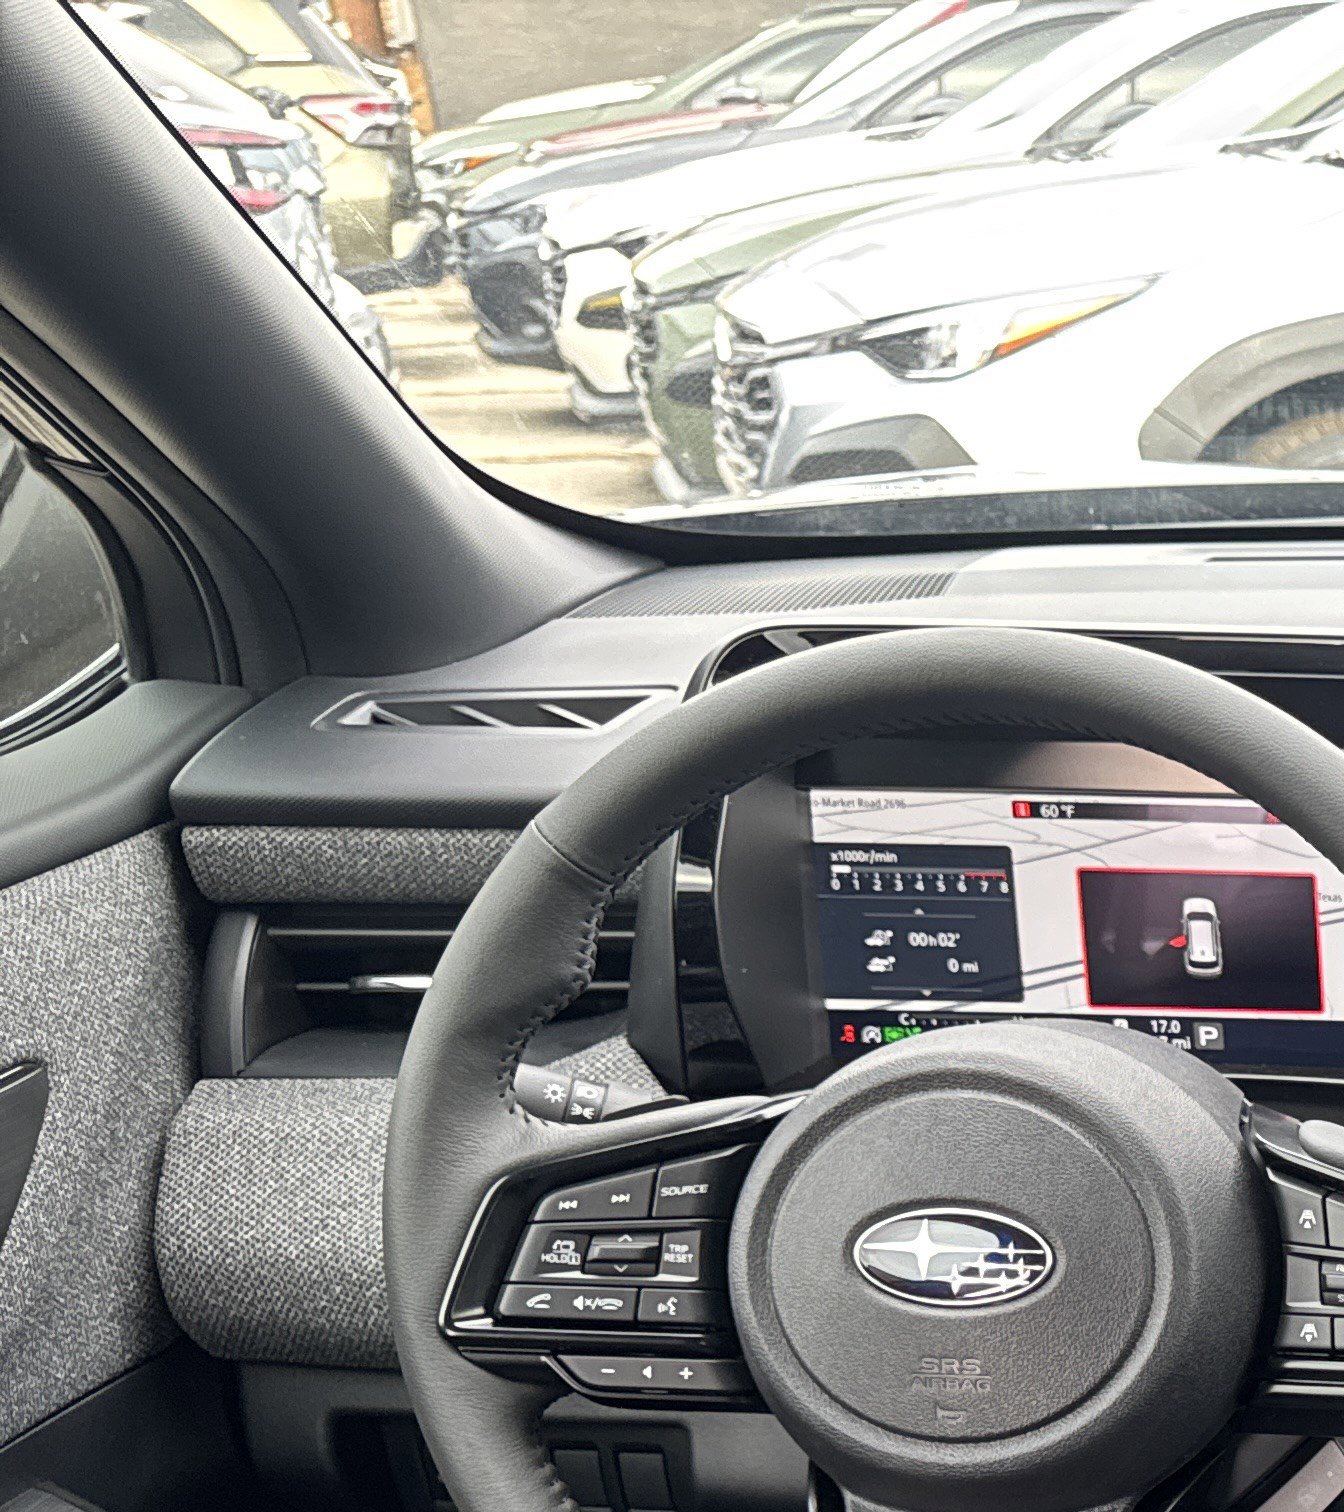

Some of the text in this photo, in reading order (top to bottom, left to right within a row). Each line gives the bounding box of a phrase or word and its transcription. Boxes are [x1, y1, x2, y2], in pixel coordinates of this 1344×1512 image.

[857, 798, 883, 810] Road
[829, 849, 899, 865] x1000r/min
[831, 879, 1009, 894] 0 1 2 3 4 5 6 7 8
[946, 957, 980, 974] 0 mi
[898, 1012, 909, 1026] C
[1149, 1018, 1182, 1035] 17.0
[1198, 1025, 1219, 1047] P
[660, 1183, 710, 1198] SOURCE
[668, 1243, 690, 1253] TRIP
[540, 1252, 570, 1265] HOLD
[663, 1252, 694, 1264] RESET
[919, 1357, 982, 1375] SRS
[911, 1374, 993, 1393] AIRBAG
